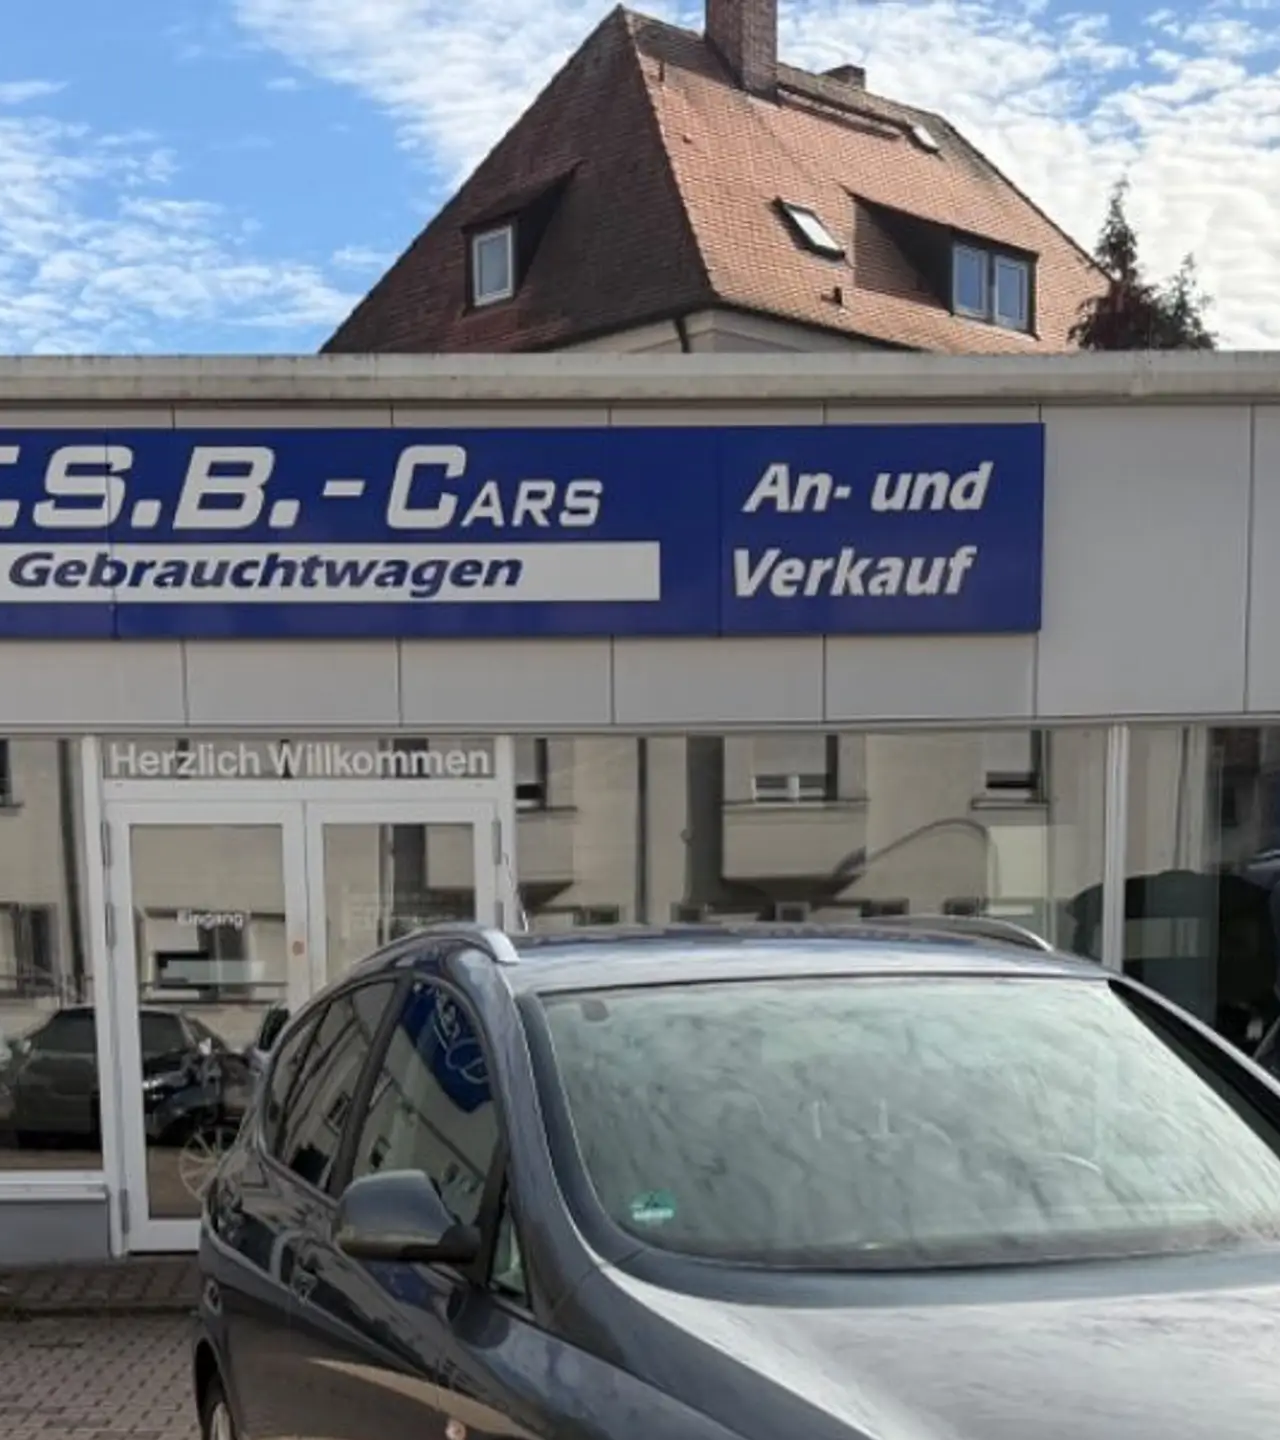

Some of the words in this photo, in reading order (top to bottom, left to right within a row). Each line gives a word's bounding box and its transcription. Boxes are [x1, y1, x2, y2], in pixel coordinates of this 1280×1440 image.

[743, 463, 851, 512] An-
[871, 462, 993, 511] und
[8, 551, 523, 600] Gebrauchtwagen
[734, 546, 978, 597] Verkauf
[109, 741, 261, 777] Herzlich
[268, 741, 490, 777] Willkommen
